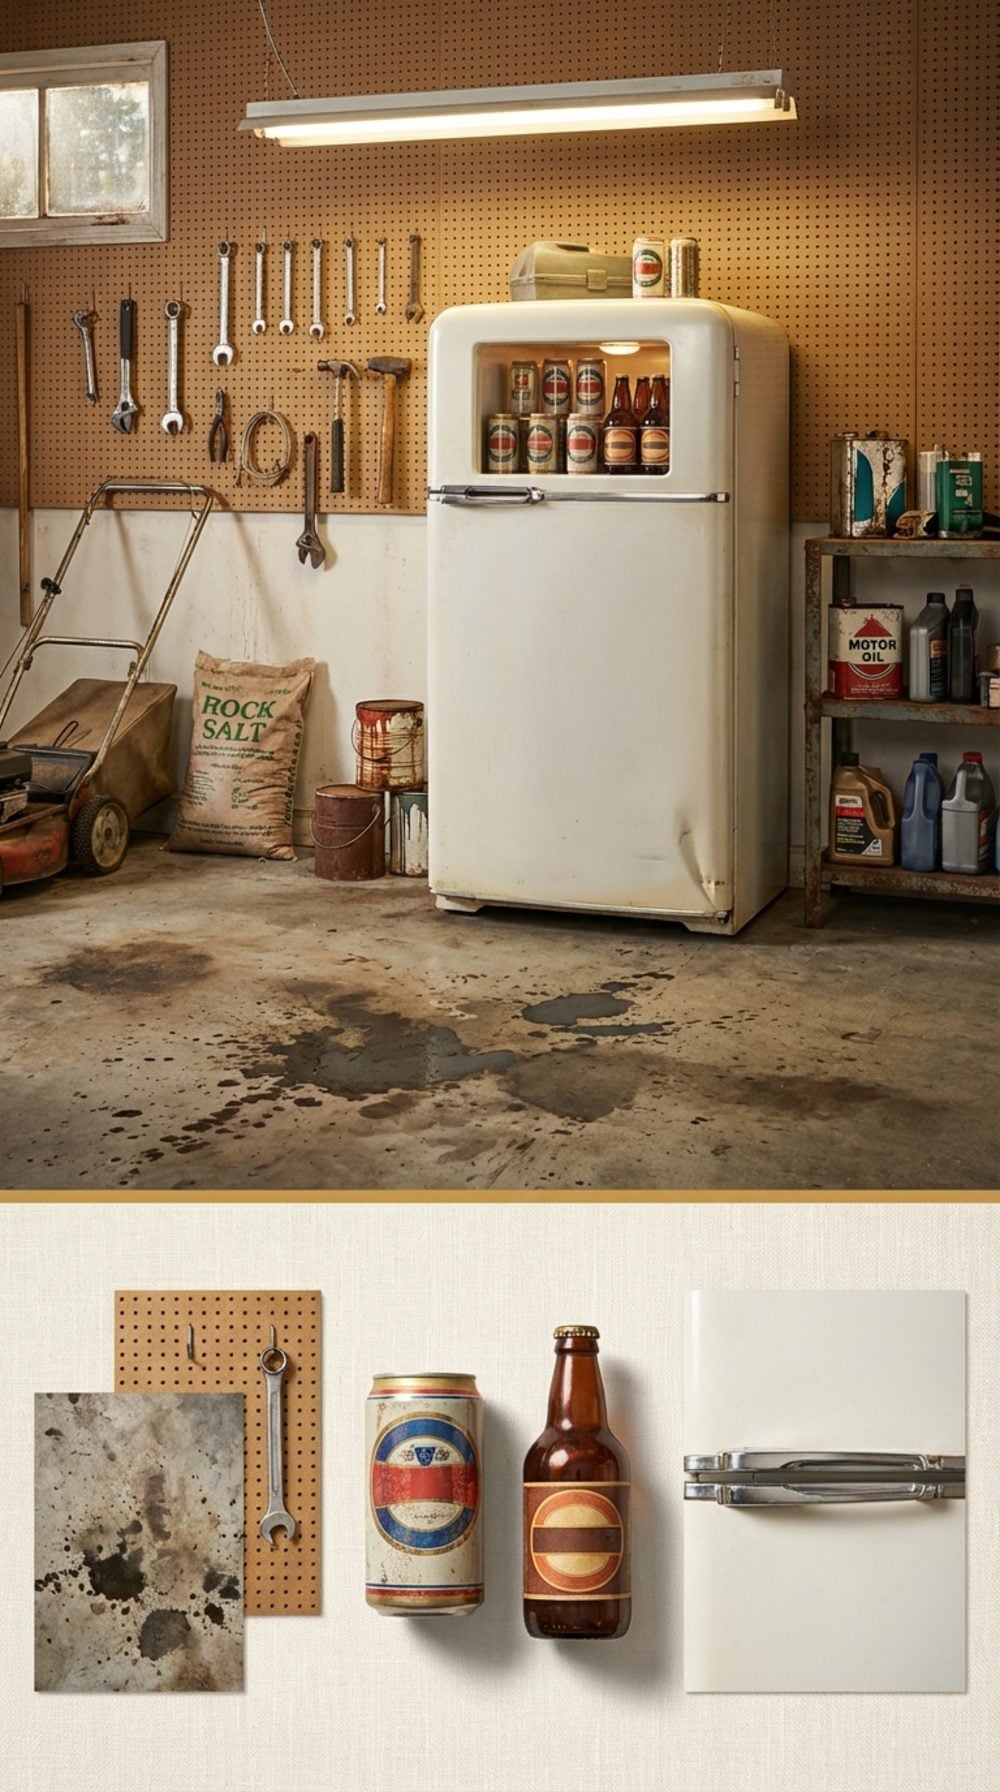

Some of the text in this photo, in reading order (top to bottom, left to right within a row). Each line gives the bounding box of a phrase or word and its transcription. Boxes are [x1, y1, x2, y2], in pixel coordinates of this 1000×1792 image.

[848, 638, 897, 651] MOTOR
[862, 651, 884, 662] OIL
[202, 695, 277, 719] ROCK
[202, 719, 267, 742] SALT
